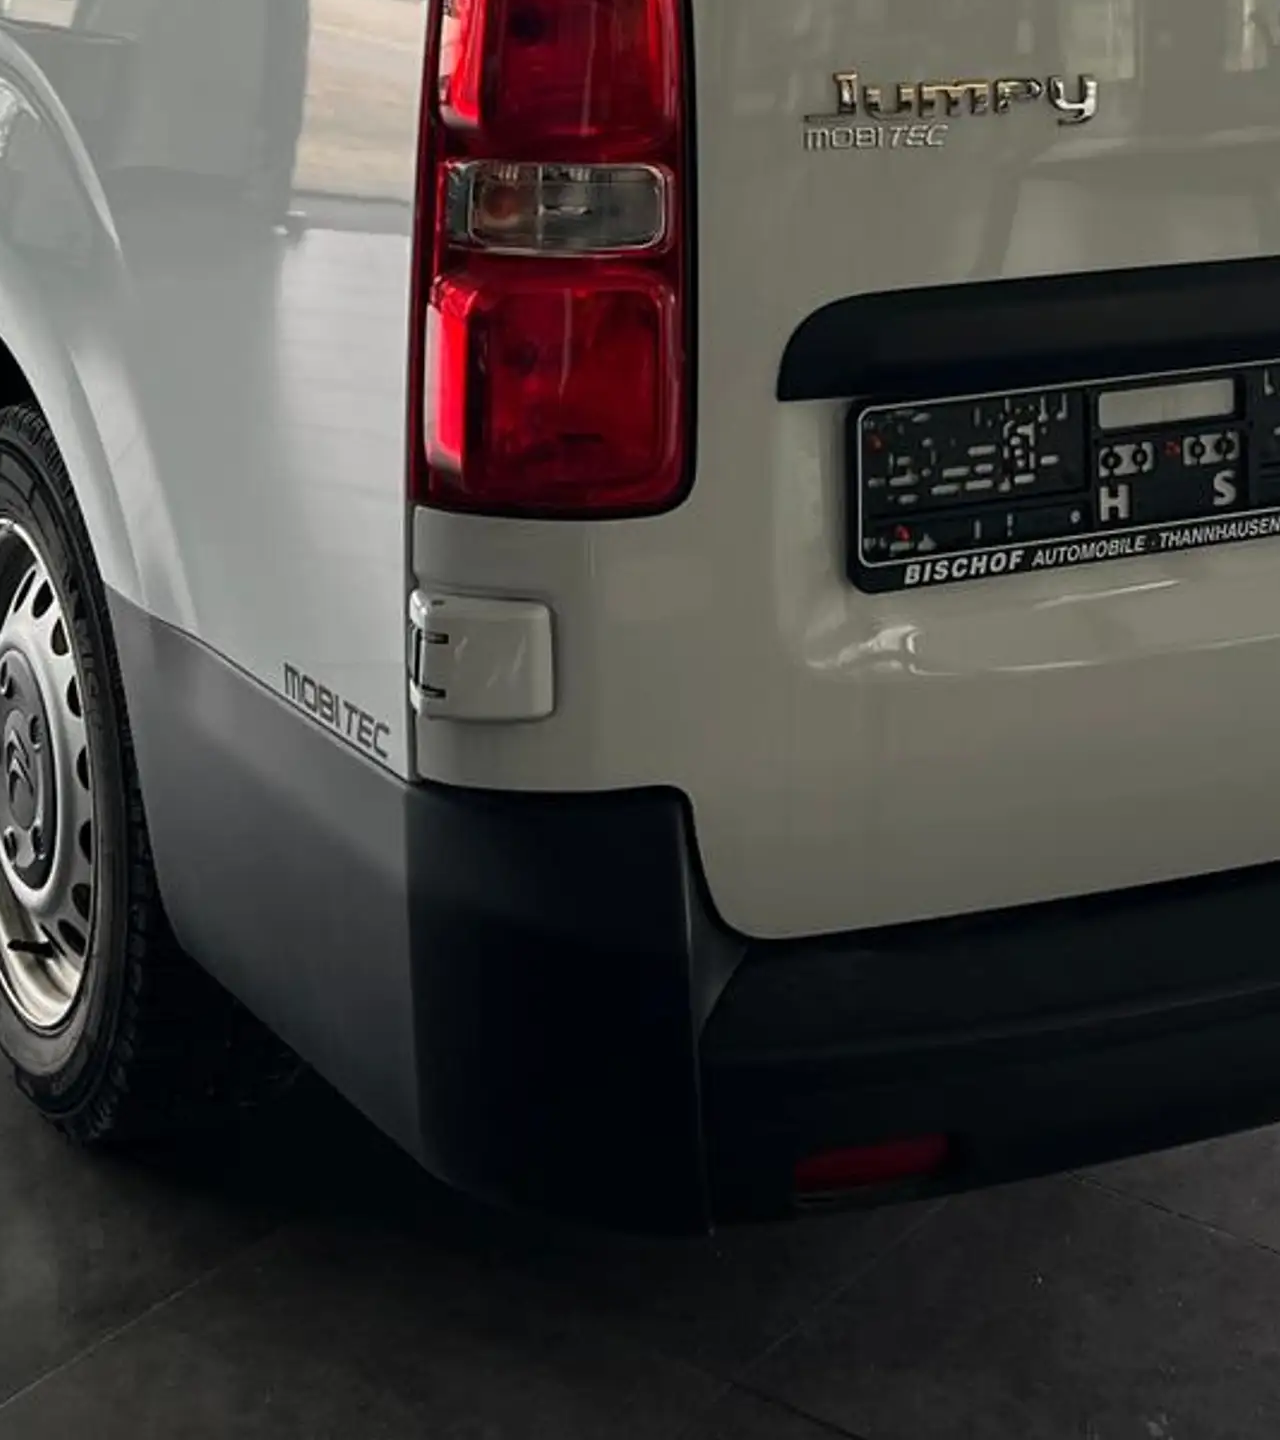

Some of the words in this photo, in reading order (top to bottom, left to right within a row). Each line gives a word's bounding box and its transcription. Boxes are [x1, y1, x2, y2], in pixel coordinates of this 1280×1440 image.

[803, 71, 1098, 126] Jumpy
[904, 550, 1024, 585] BISCHOF
[1031, 533, 1149, 568] AUTOMOBILE
